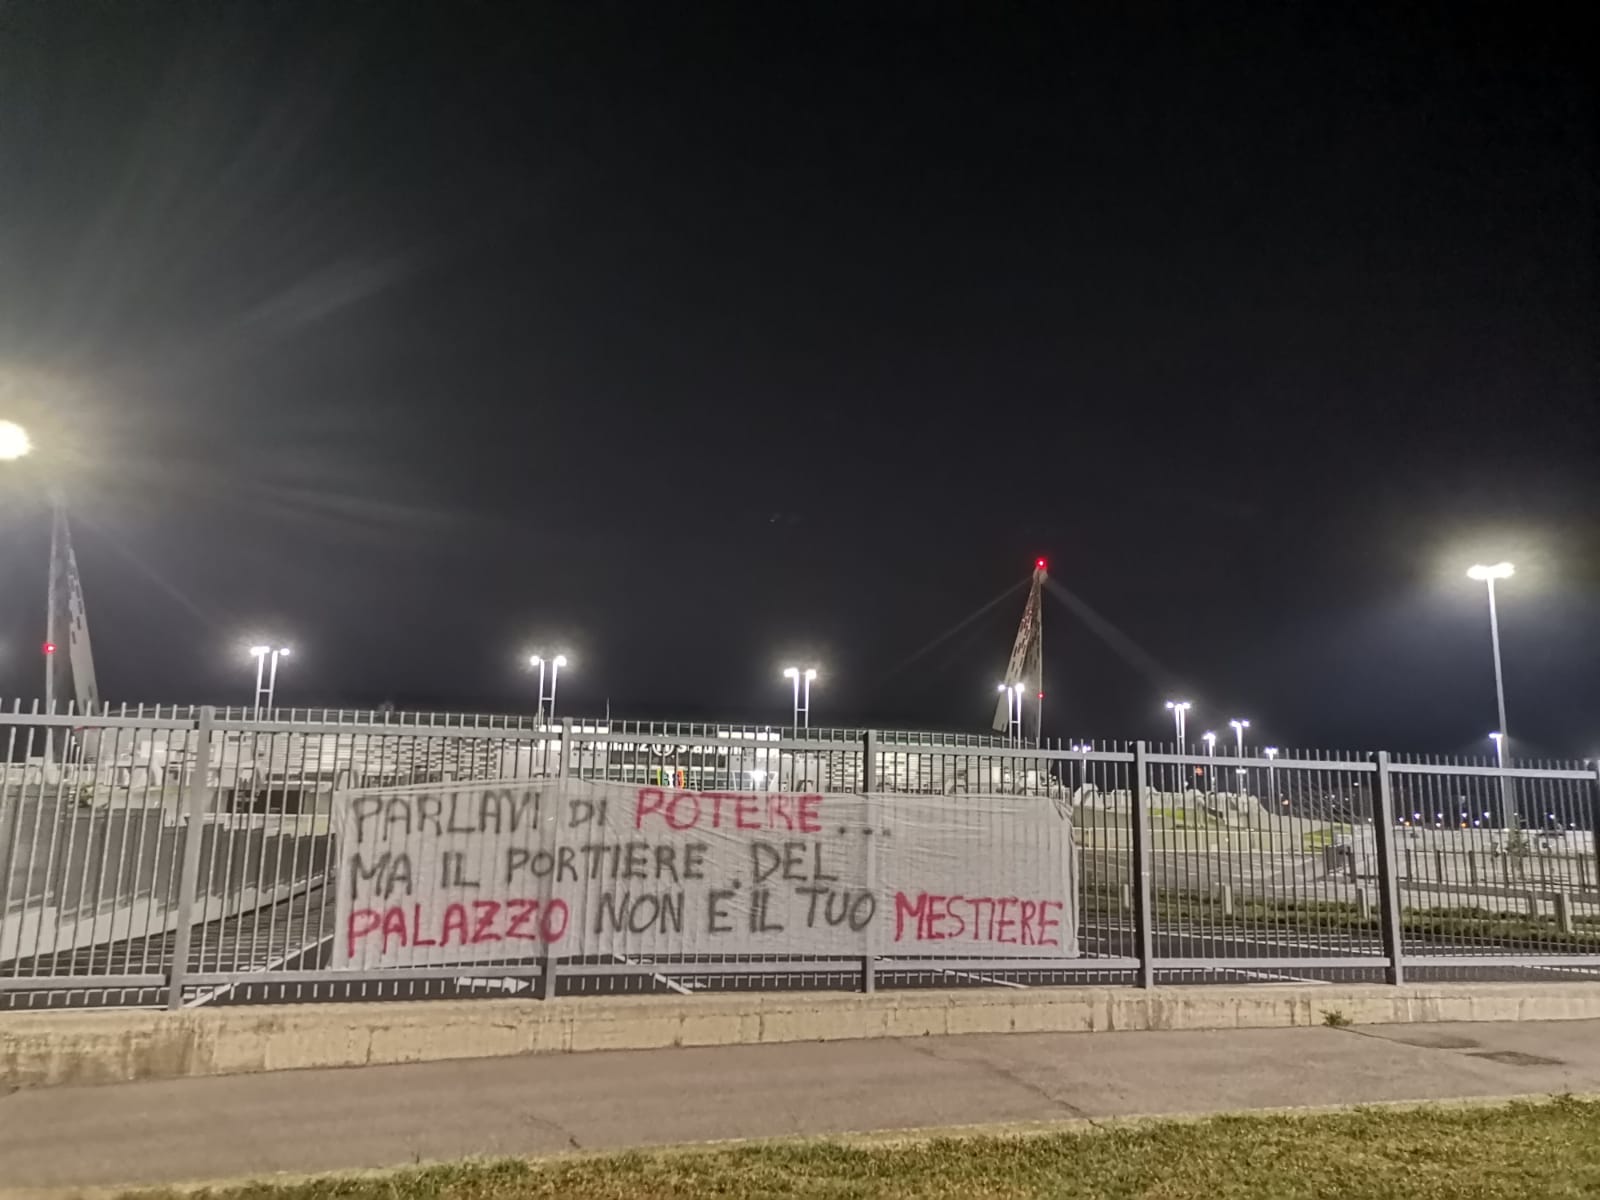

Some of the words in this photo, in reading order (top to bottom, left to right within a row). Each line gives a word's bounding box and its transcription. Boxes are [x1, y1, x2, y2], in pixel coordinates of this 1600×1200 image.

[352, 789, 541, 842] PARLAVI
[568, 798, 608, 829] DI
[350, 851, 414, 900] MA
[441, 851, 481, 888] IL
[507, 842, 709, 883] PORTIERE
[750, 840, 838, 884] DEL
[347, 898, 570, 959] PALAZZO
[594, 889, 685, 935] NON
[751, 888, 784, 933] IL
[794, 885, 877, 932] TUO
[894, 890, 1064, 946] MESTIERE
